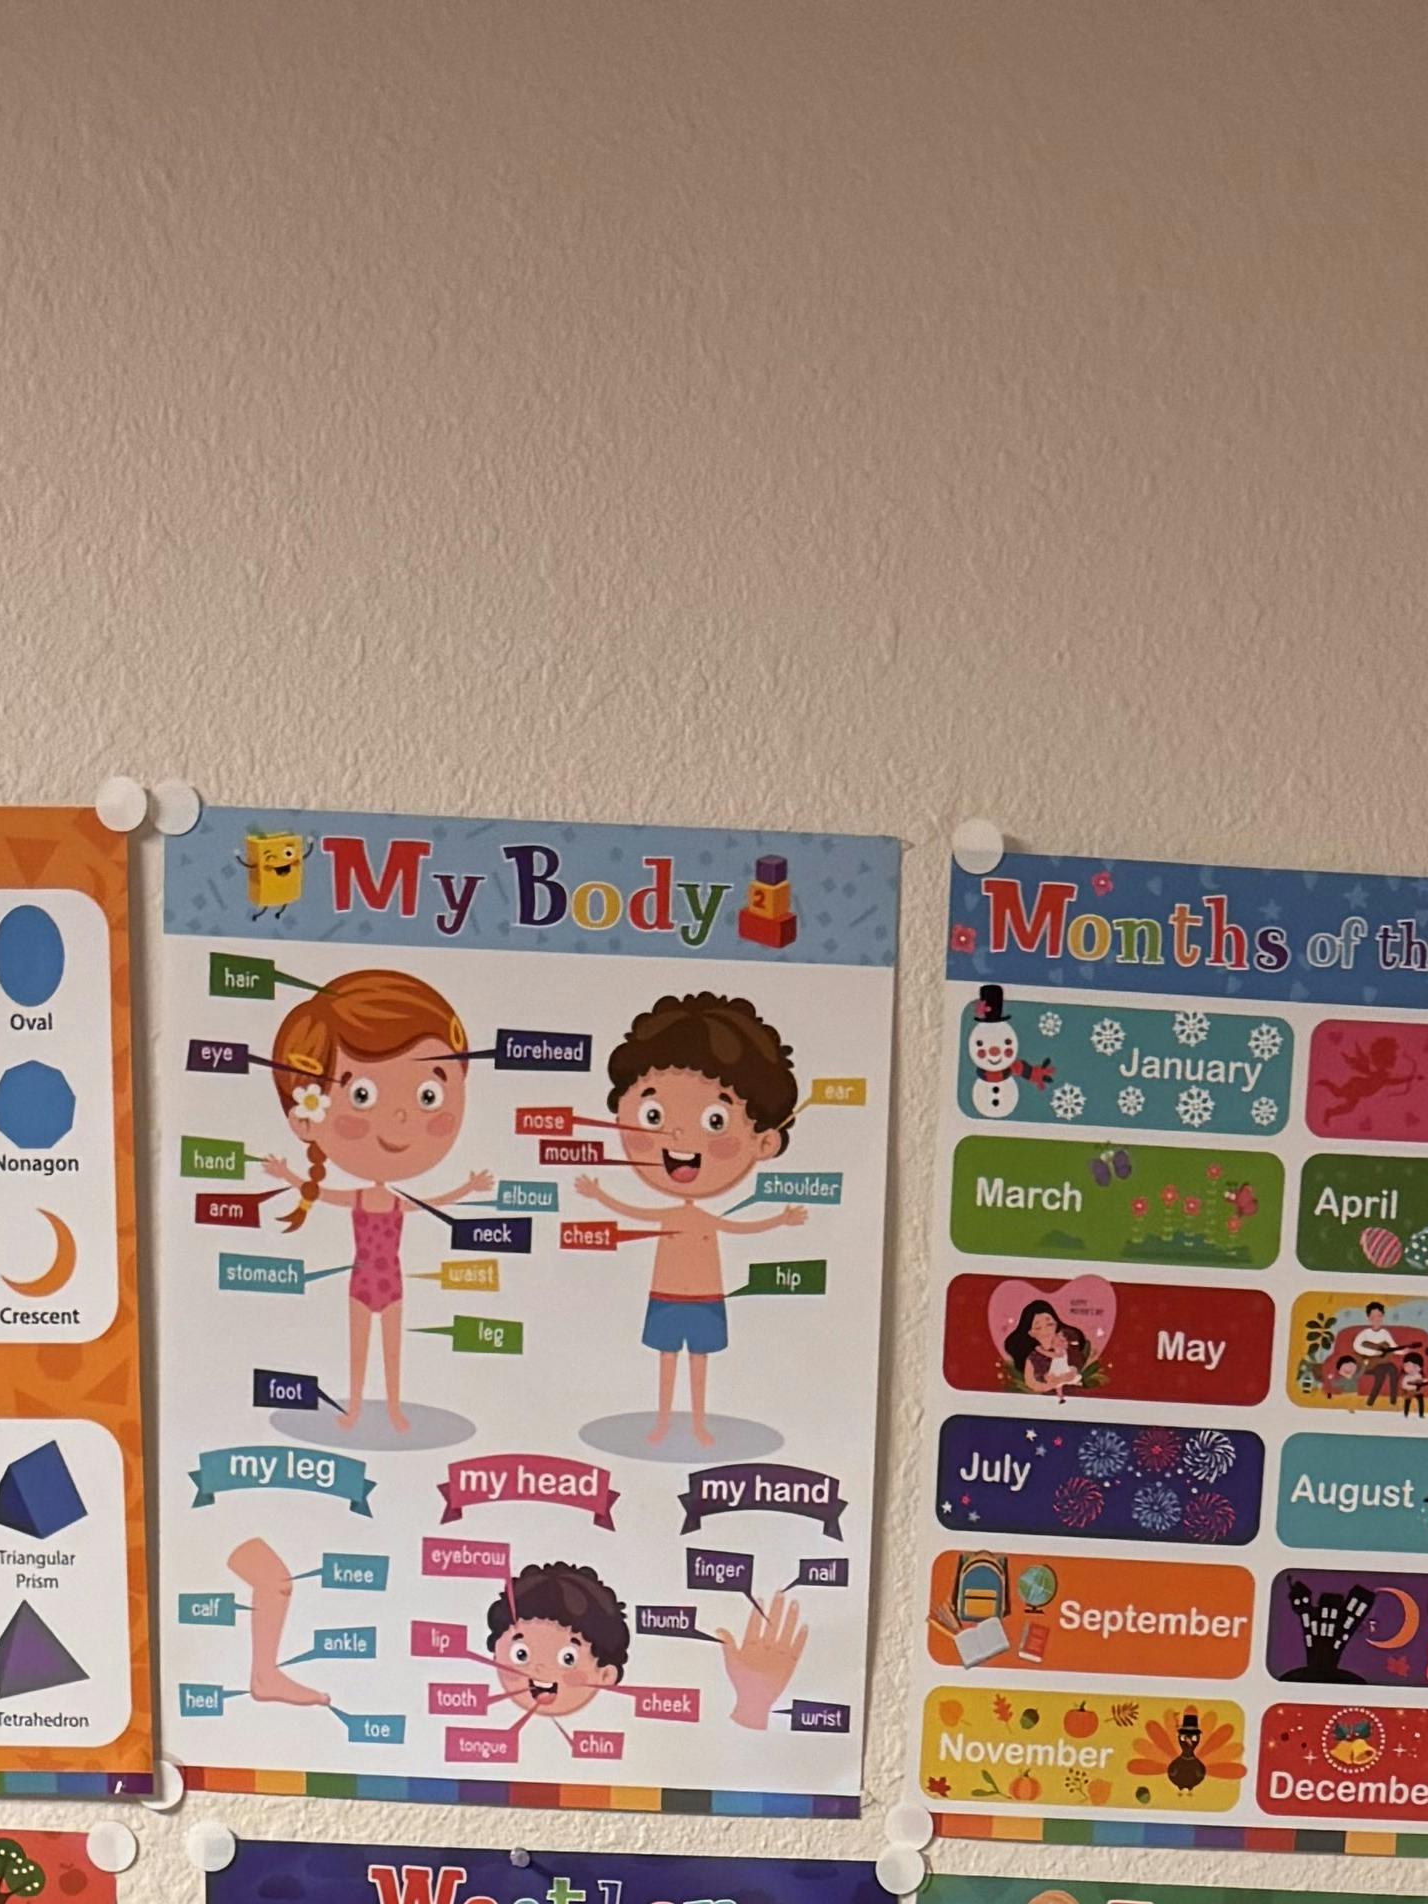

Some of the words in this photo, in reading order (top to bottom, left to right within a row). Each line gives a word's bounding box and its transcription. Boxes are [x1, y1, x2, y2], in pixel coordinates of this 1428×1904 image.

[322, 836, 485, 936] My
[502, 843, 733, 947] Body
[981, 877, 1292, 972] Months
[1307, 916, 1368, 969] of
[224, 969, 260, 989] hair
[201, 1044, 233, 1066] eye
[506, 1038, 585, 1062] forehead
[1119, 1047, 1263, 1092] January
[523, 1112, 565, 1130] nose
[545, 1143, 599, 1164] mouth
[502, 1186, 553, 1207] elbow
[764, 1177, 840, 1197] shoulder
[976, 1178, 1083, 1213] March
[1315, 1187, 1398, 1222] April
[473, 1224, 512, 1245] neck
[563, 1226, 610, 1246] chest
[776, 1267, 801, 1291] hip
[0, 1307, 80, 1325] Crescent
[1156, 1330, 1226, 1365] May
[230, 1455, 278, 1482] my
[286, 1451, 335, 1488] leg
[458, 1467, 508, 1498] my
[515, 1464, 599, 1497] head
[960, 1451, 1031, 1492] July
[701, 1477, 748, 1506] my
[754, 1476, 830, 1504] hand
[1290, 1475, 1415, 1513] August
[333, 1565, 374, 1583] knee
[640, 1609, 689, 1629] thumb
[1059, 1601, 1248, 1641] September
[800, 1709, 842, 1728] wrist
[939, 1732, 1114, 1769] November
